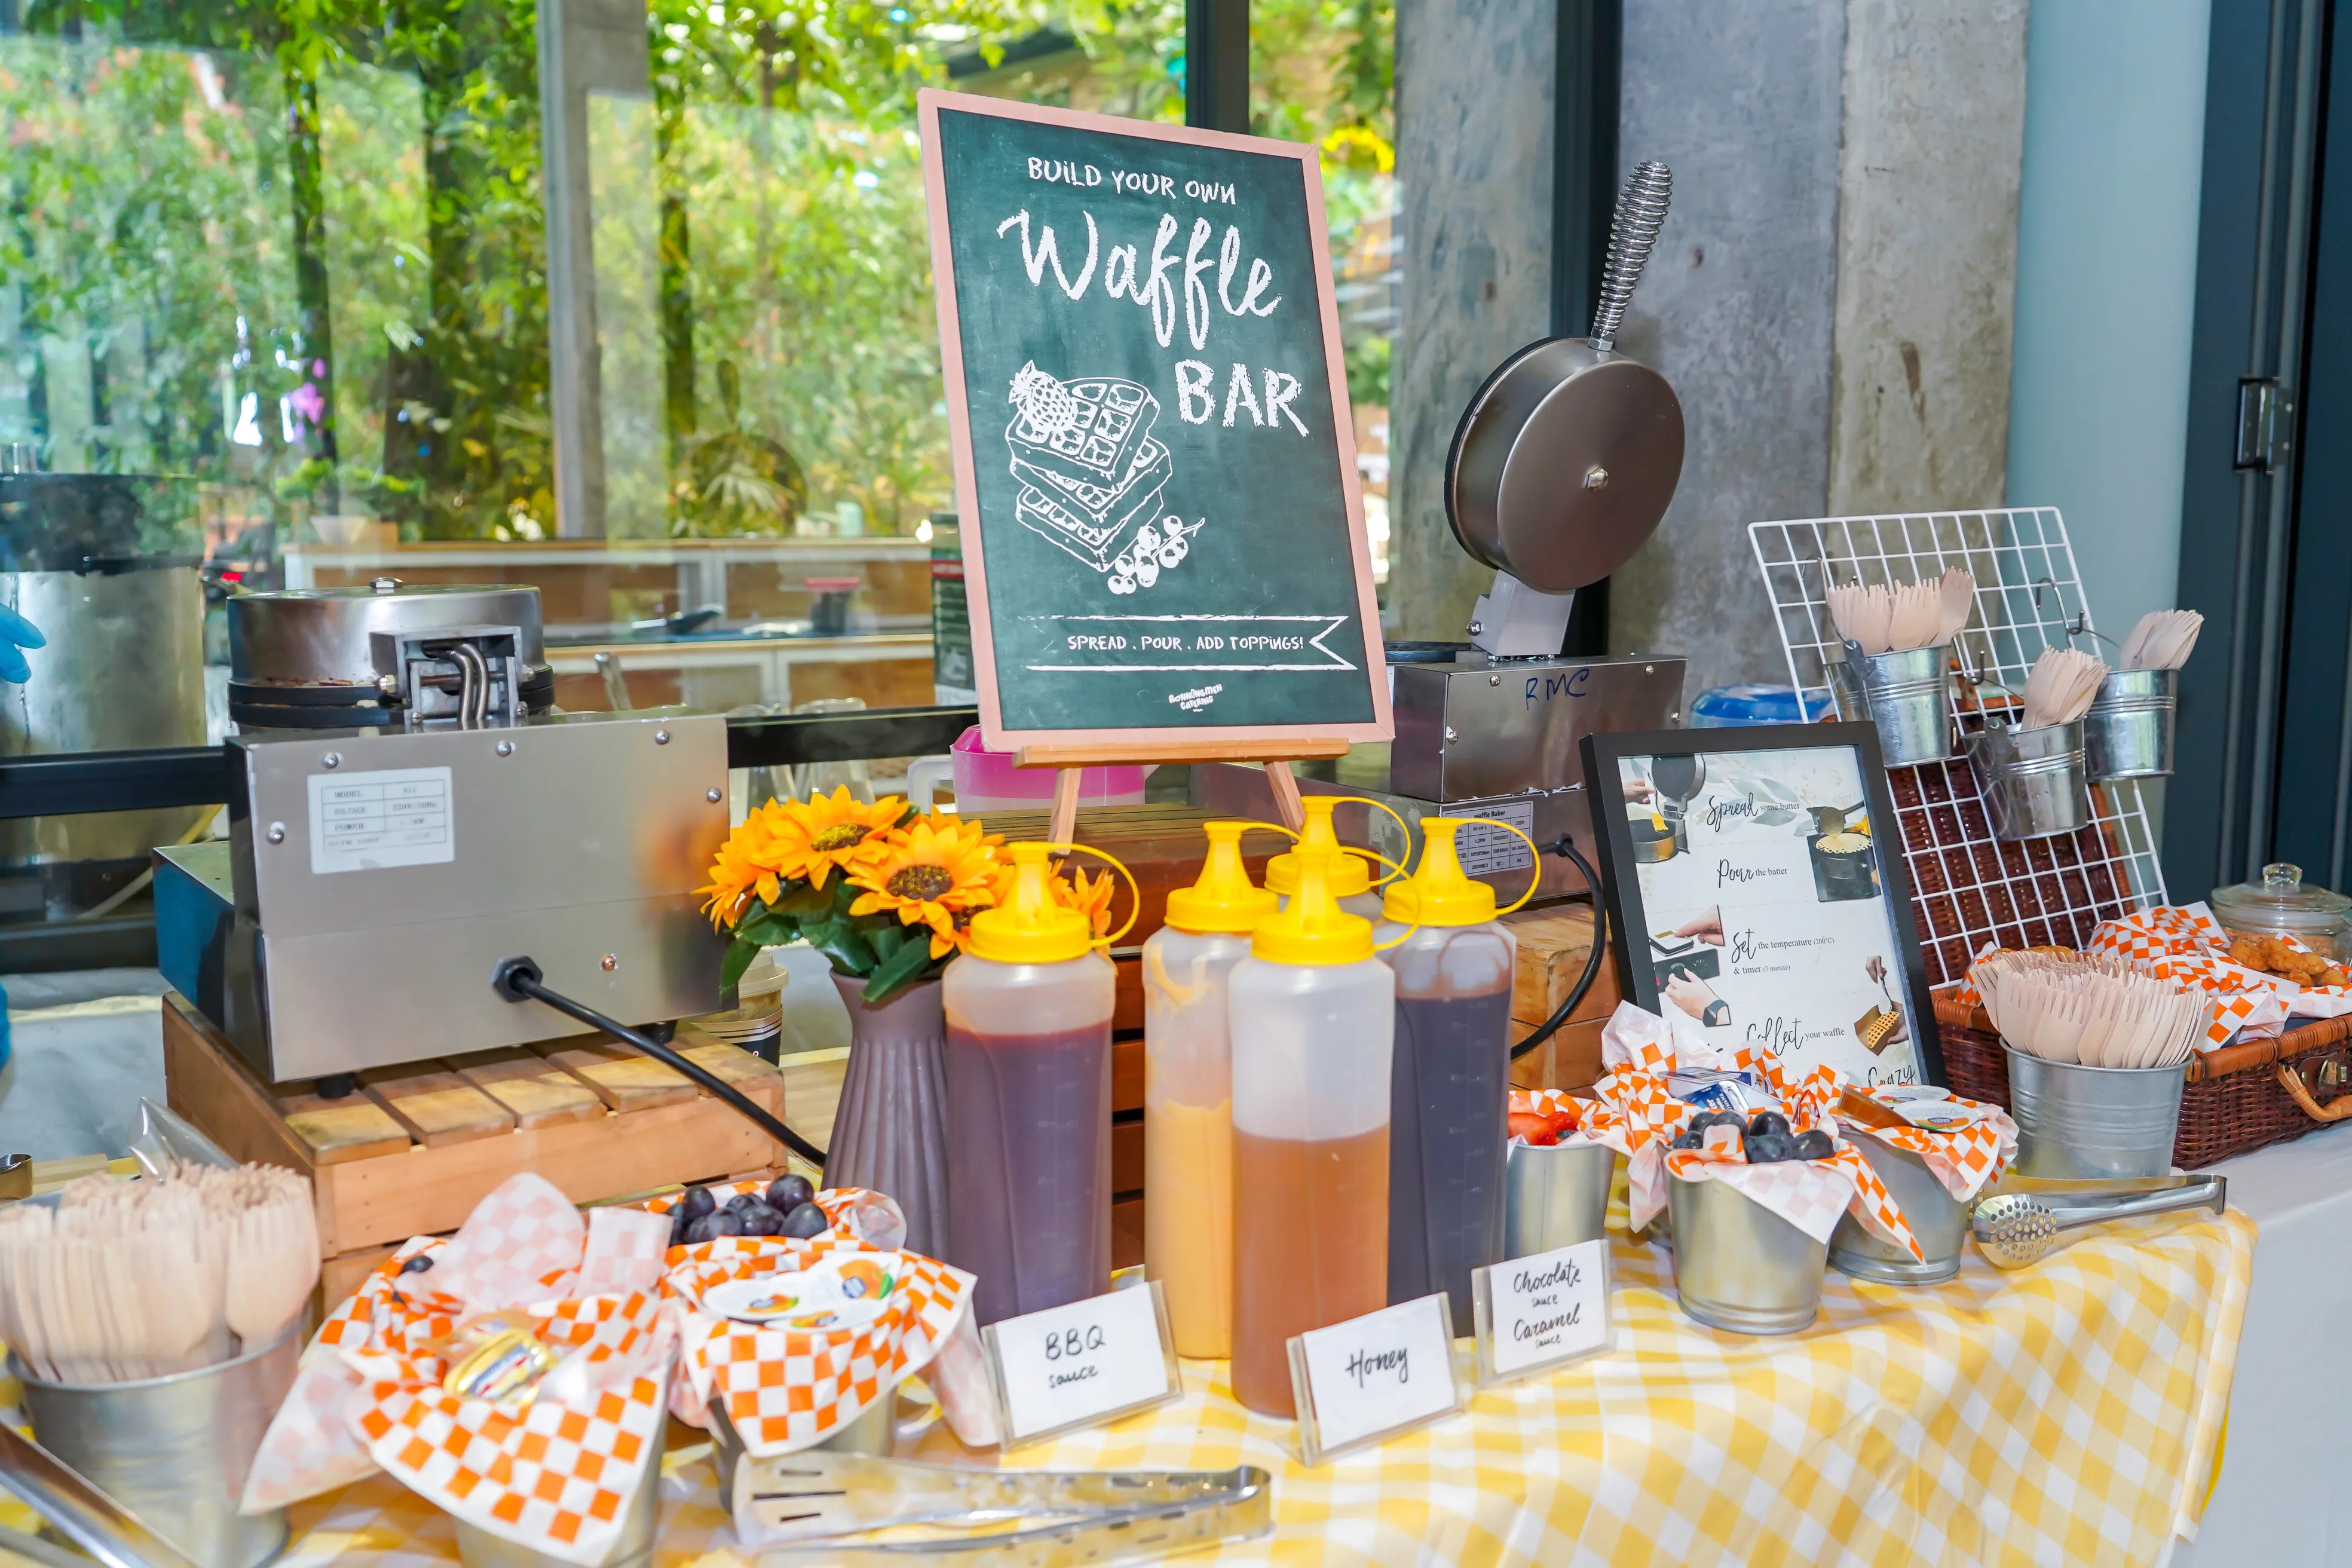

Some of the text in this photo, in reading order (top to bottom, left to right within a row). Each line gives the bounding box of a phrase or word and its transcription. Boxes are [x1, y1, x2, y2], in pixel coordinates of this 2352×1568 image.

[1111, 170, 1177, 200] YOUR
[1185, 180, 1237, 205] OWN
[996, 209, 1282, 350] Waffle
[1175, 359, 1309, 438] BAR
[1067, 636, 1127, 651] SPREAD
[1141, 637, 1183, 651] POUR
[1196, 636, 1224, 650] ADD
[1180, 695, 1214, 710] CATERING
[1526, 668, 1590, 711] RMC
[334, 806, 366, 814] VOLTAGE
[1707, 792, 1759, 832] Spread
[335, 822, 365, 831] POWER
[1717, 859, 1754, 889] Pour
[1768, 868, 1787, 876] batter
[1731, 928, 1757, 963] Set
[1758, 941, 1769, 950] the
[1771, 939, 1812, 950] temperature
[1734, 966, 1741, 975] &
[1742, 966, 1762, 975] timer
[1770, 964, 1791, 973] minute)
[1805, 1031, 1821, 1041] your
[1823, 1028, 1845, 1037] waffle
[1514, 1258, 1581, 1293] Chocolate
[1532, 1294, 1557, 1307] sauce
[1514, 1303, 1580, 1340] Caramel
[1046, 1325, 1105, 1361] BBQ
[1535, 1334, 1561, 1349] sauce
[1049, 1365, 1098, 1388] sauce
[1345, 1348, 1408, 1388] Honey
